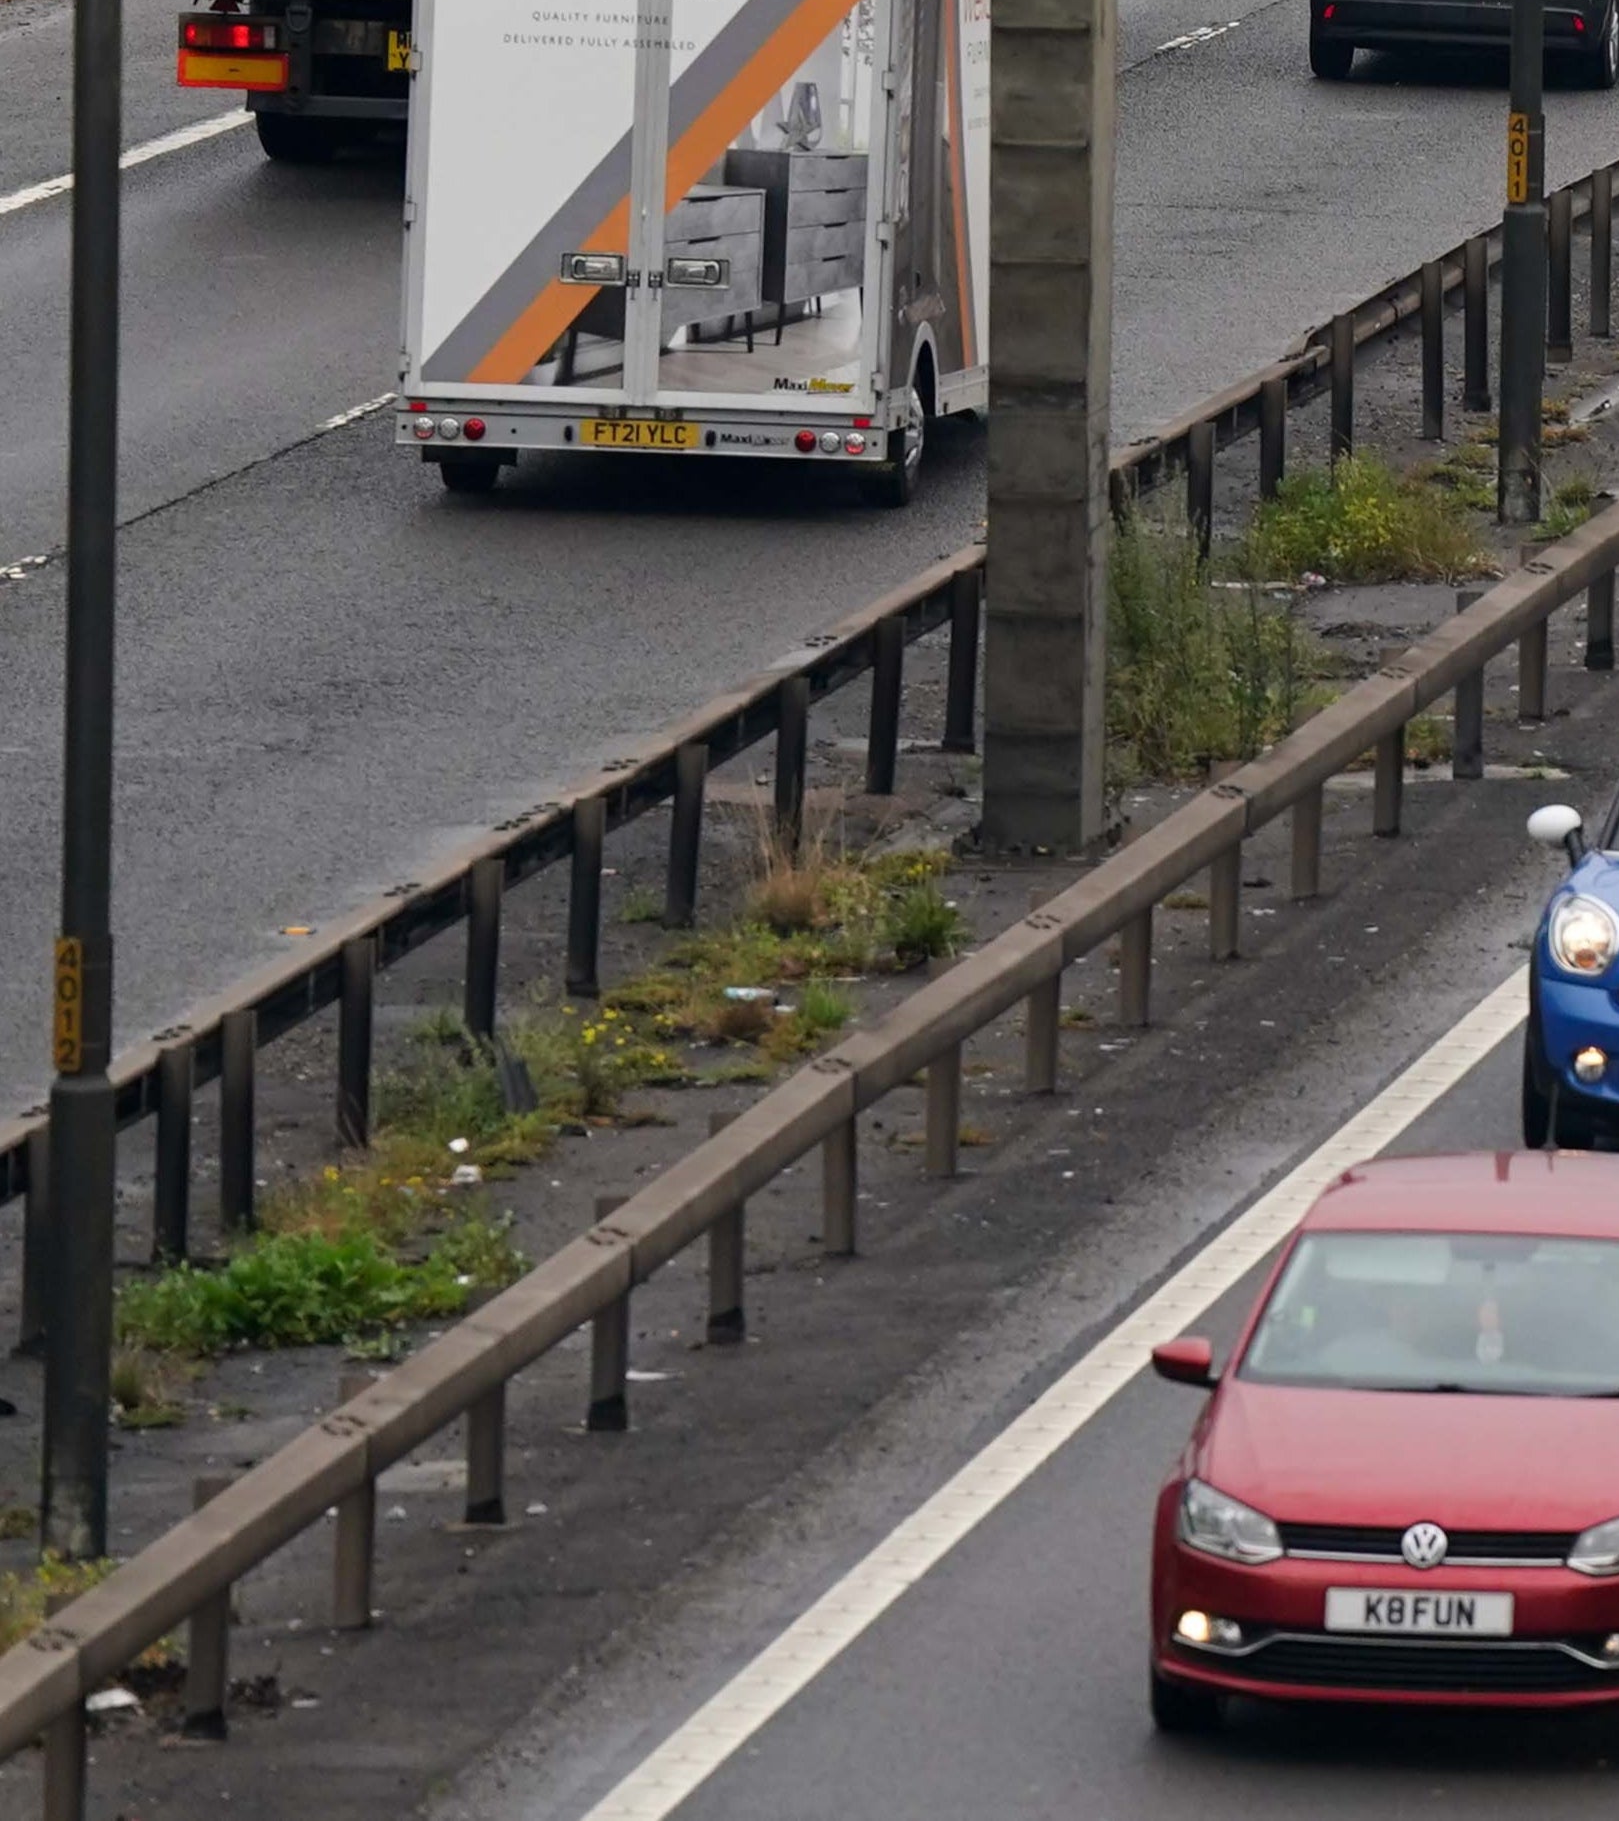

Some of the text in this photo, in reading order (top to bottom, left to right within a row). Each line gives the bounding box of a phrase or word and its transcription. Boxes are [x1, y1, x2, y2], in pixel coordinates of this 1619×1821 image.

[532, 11, 669, 26] QUALITY FURNITURE
[503, 33, 697, 51] DELIVERED FULLY ASSEMBLED
[1510, 118, 1526, 198] 4011
[594, 421, 687, 444] FT21 YLC
[56, 943, 79, 1068] 4012
[1364, 1595, 1476, 1630] K8 FUN
